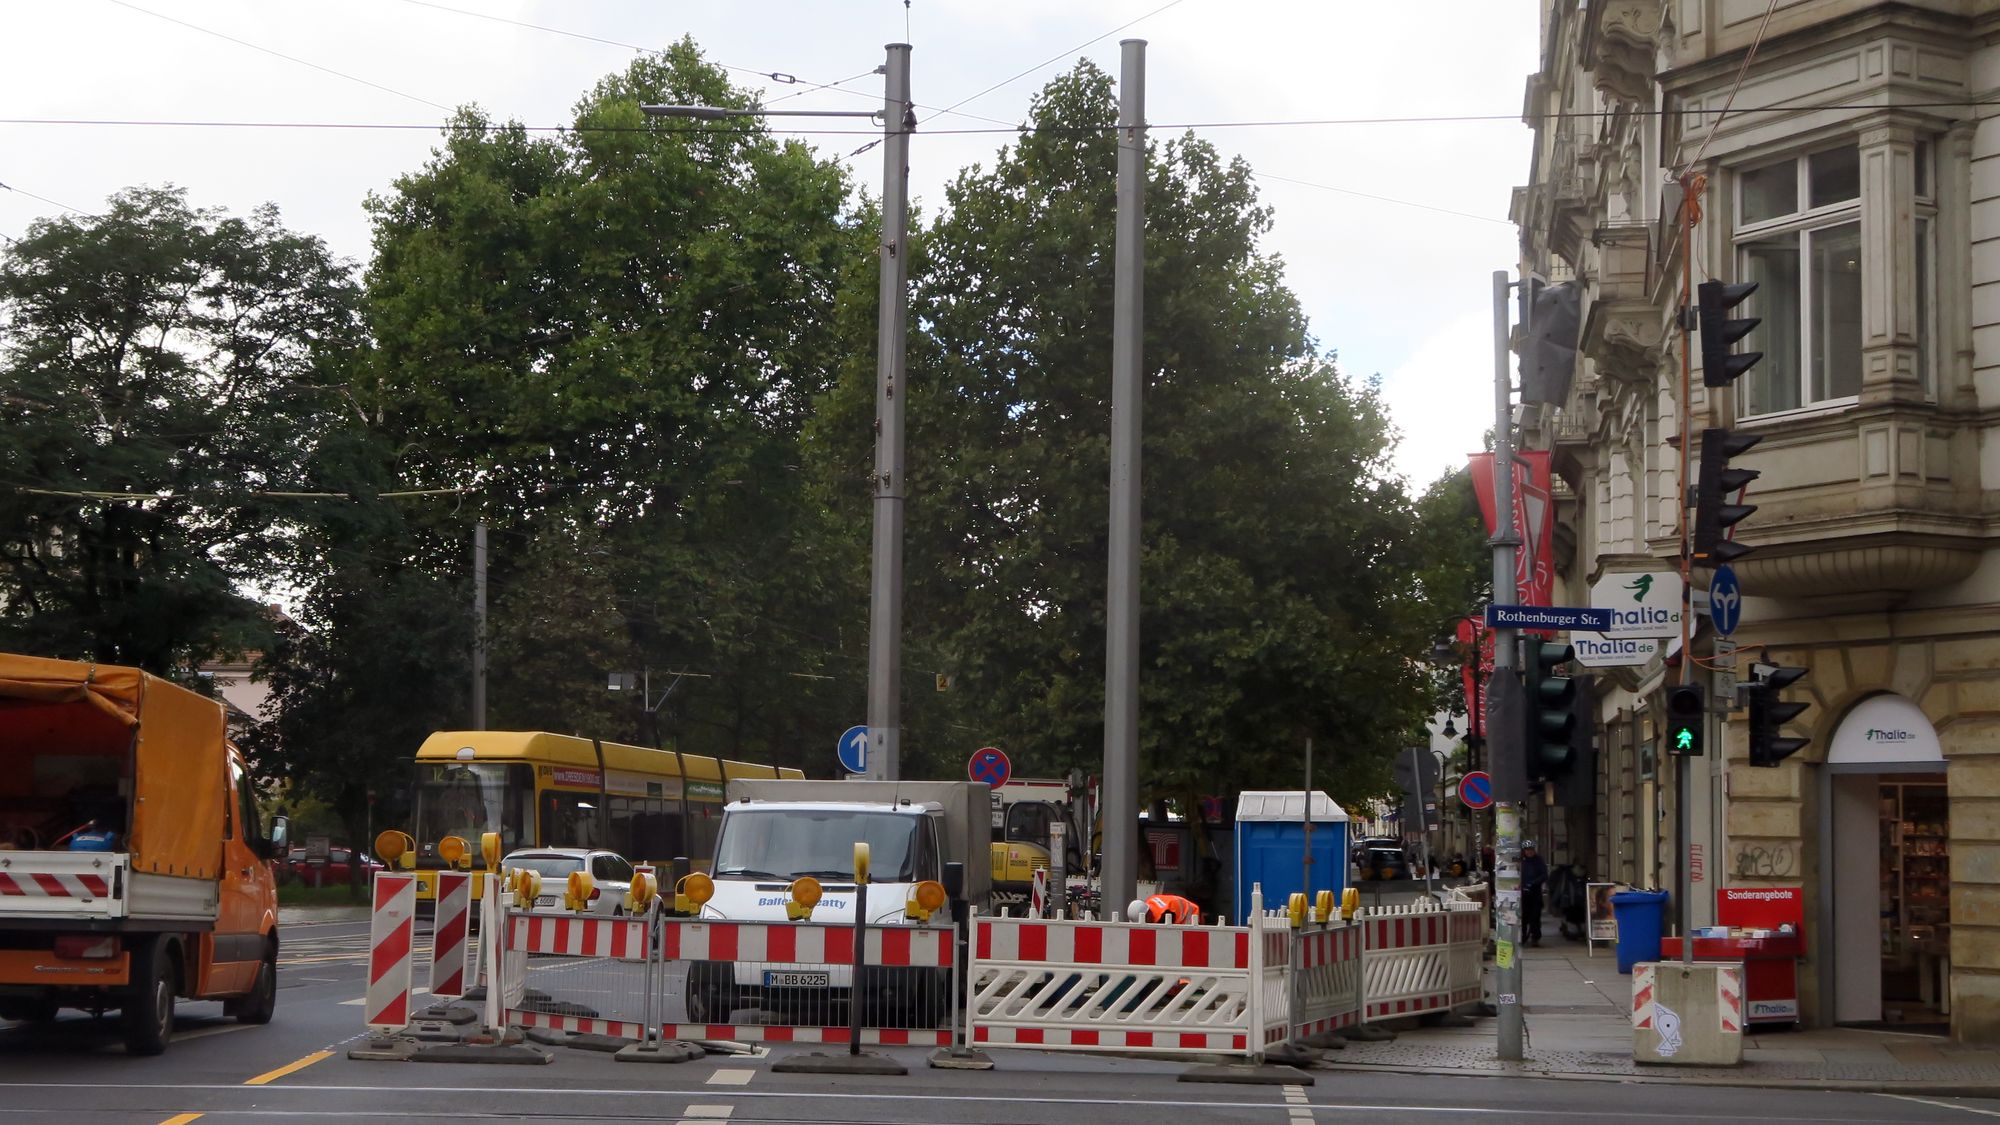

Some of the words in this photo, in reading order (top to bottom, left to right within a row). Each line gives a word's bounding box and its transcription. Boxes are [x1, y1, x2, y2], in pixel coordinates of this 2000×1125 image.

[1497, 610, 1577, 626] Rothenburger
[1581, 614, 1601, 625] Str.
[1727, 889, 1793, 902] Sonderangebote
[800, 975, 826, 986] 6225
